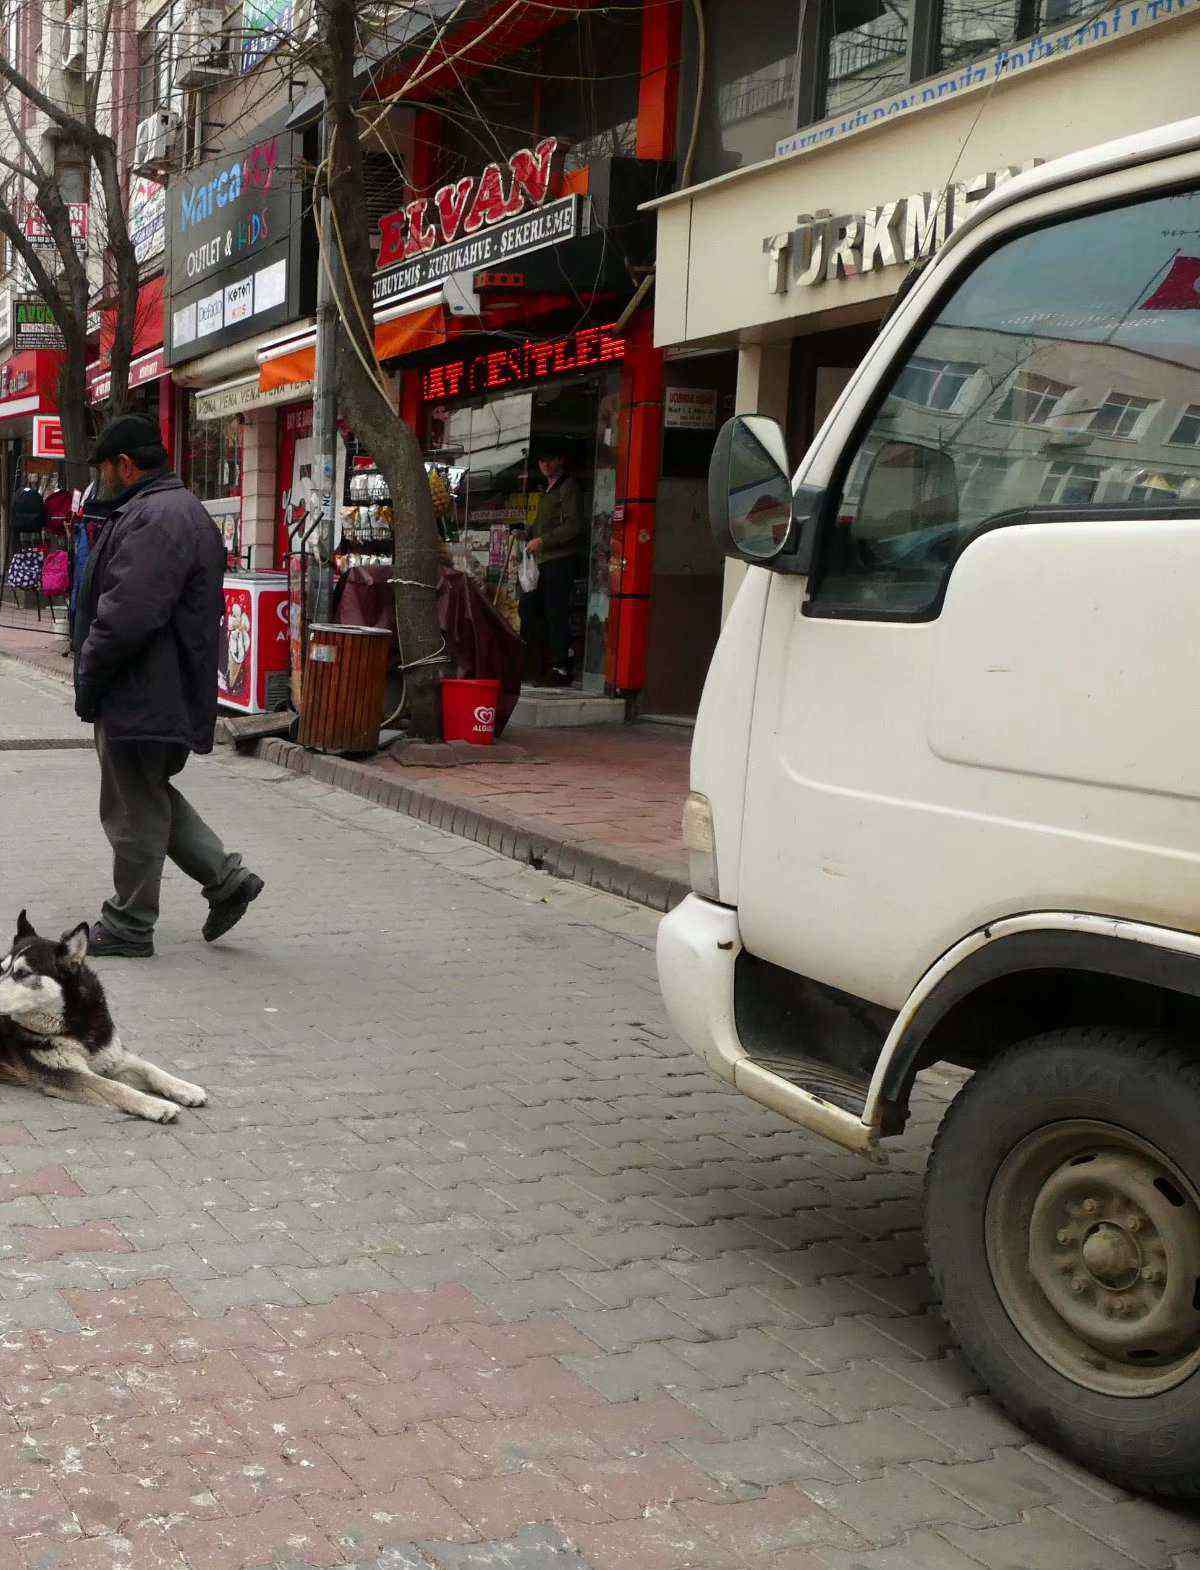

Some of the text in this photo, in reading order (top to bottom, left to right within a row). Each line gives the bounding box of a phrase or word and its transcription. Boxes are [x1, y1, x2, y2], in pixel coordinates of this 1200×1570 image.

[376, 137, 557, 269] ELVAN
[762, 157, 1046, 294] TÜRKME
[187, 236, 221, 277] OUTLET
[224, 230, 233, 256] &
[428, 238, 491, 278] KURUKAHVE
